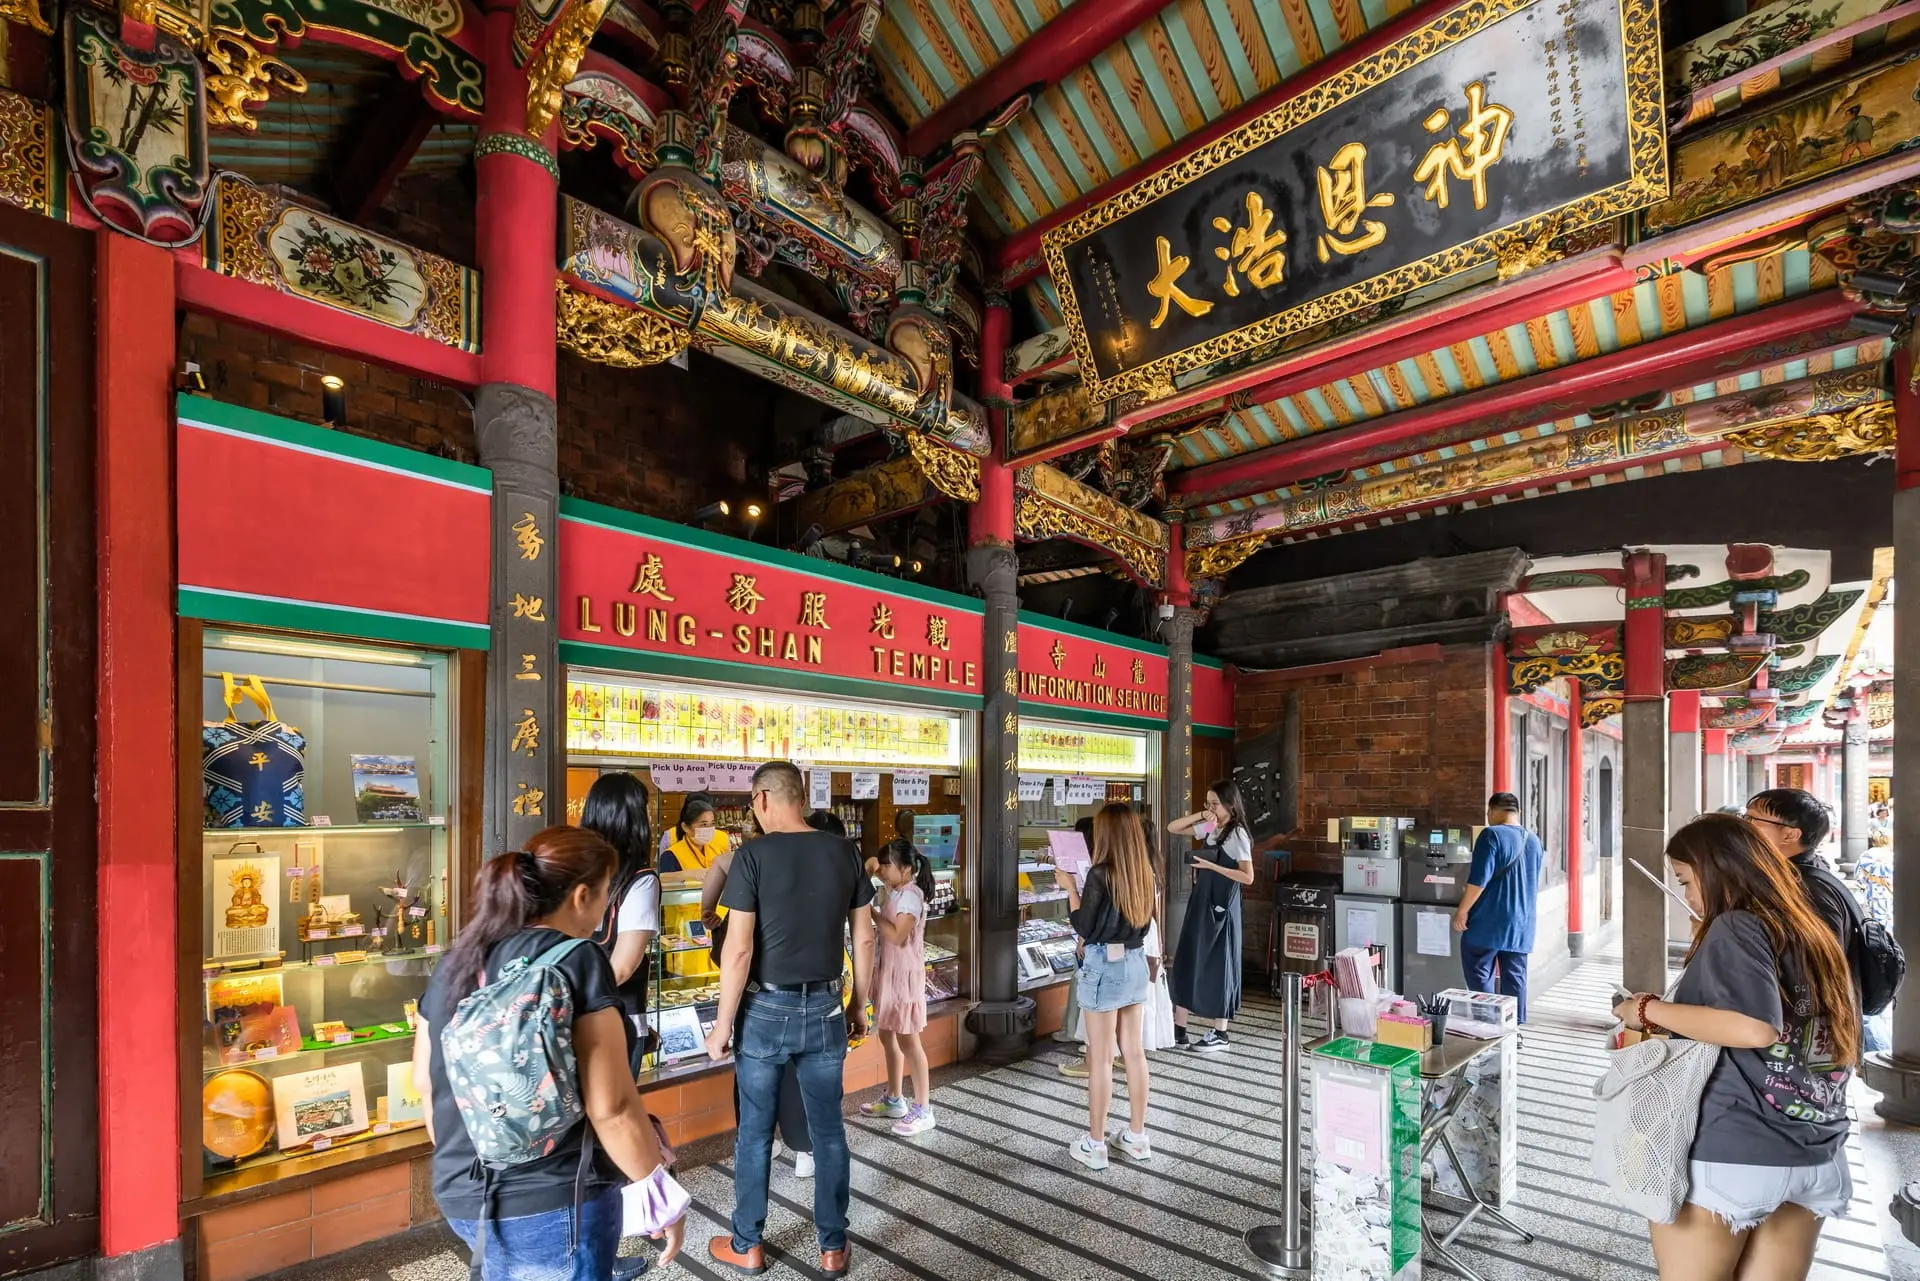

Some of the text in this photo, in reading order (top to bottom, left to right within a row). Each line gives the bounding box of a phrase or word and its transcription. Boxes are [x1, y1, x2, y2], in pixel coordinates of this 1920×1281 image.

[581, 597, 976, 687] LUNG-SHAN TEMPLE
[1020, 671, 1113, 707] INFORMATION
[652, 763, 671, 772] Pick
[673, 764, 685, 773] Up
[708, 762, 756, 771] Pick Up Area
[917, 778, 928, 786] Pay
